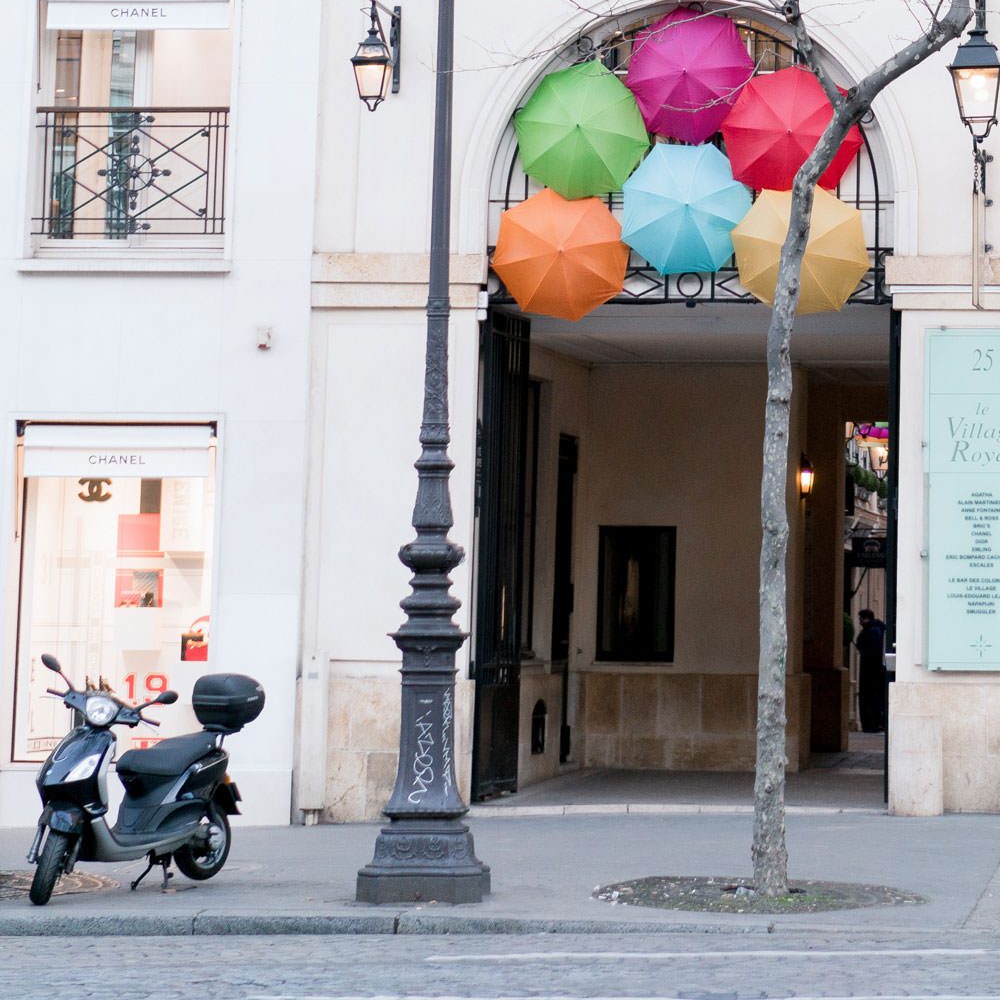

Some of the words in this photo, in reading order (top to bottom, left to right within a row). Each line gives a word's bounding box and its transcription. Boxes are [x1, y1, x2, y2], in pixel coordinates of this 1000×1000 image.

[110, 8, 167, 18] CHANEL
[972, 348, 995, 371] 25
[975, 402, 990, 416] le
[88, 454, 146, 465] CHANEL
